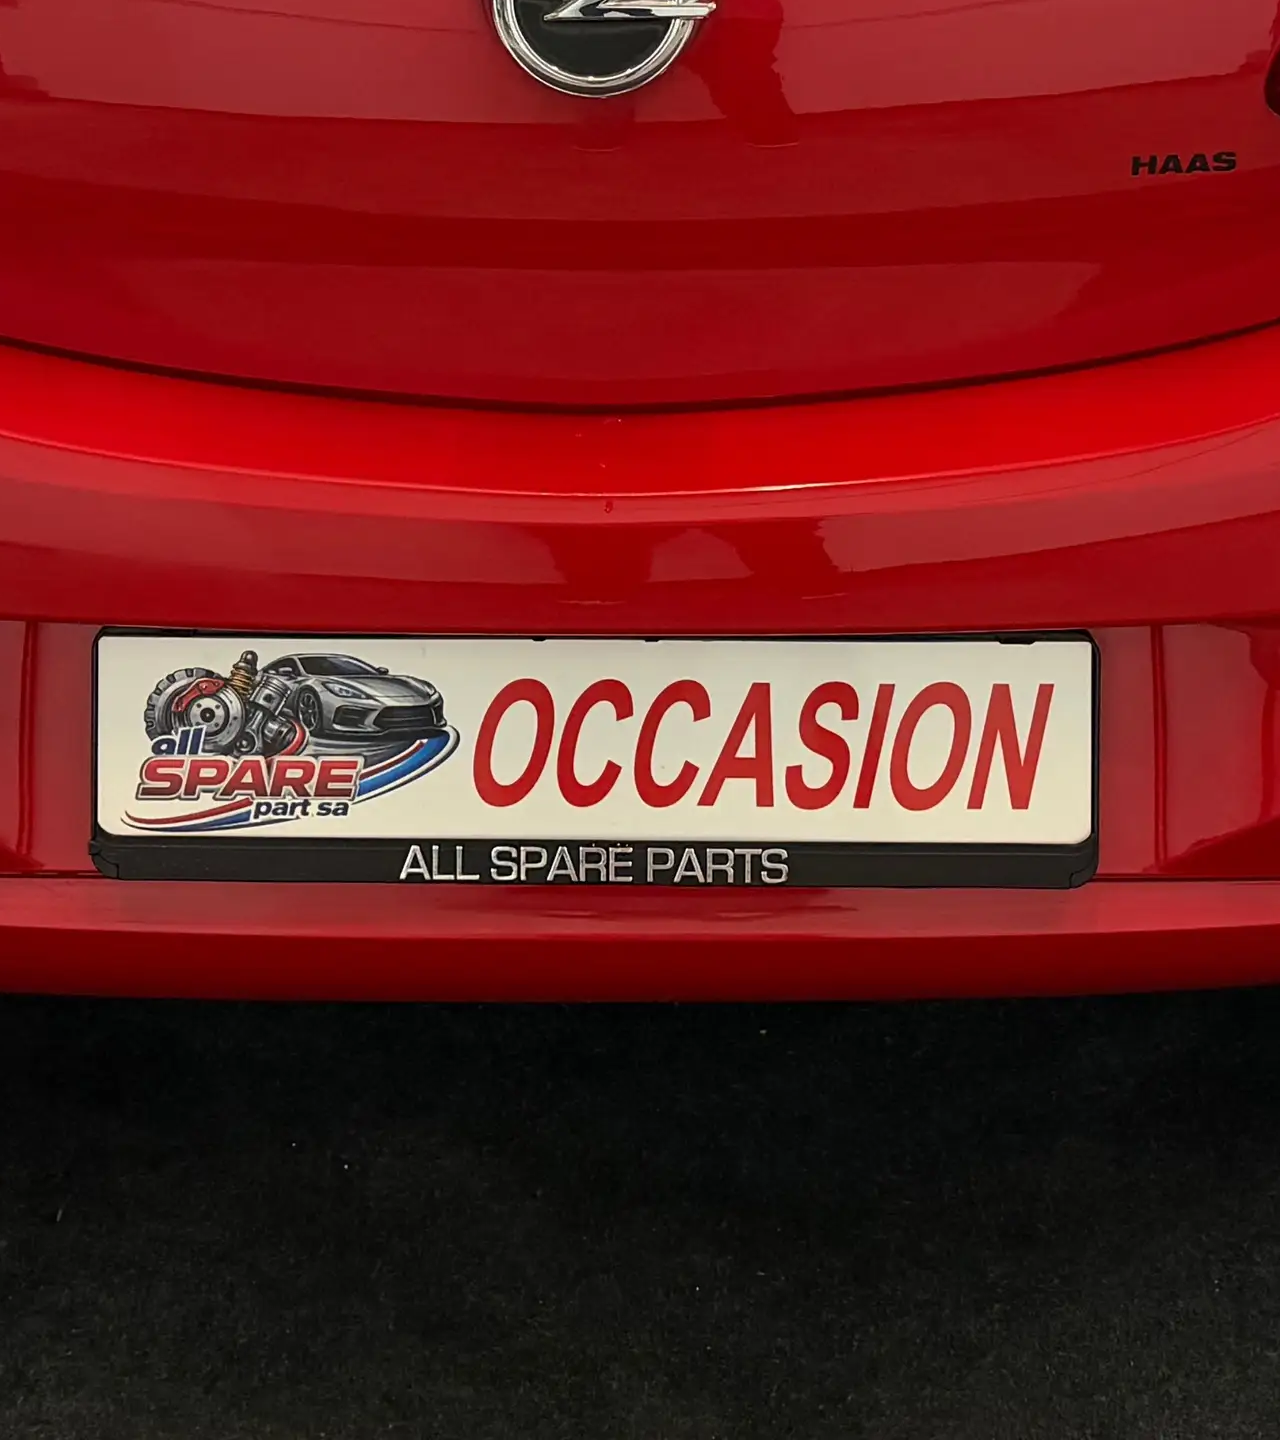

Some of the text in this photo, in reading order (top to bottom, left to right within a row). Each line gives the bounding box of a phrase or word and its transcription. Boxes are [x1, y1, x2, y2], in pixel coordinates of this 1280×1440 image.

[1131, 151, 1238, 176] HAAS
[151, 727, 205, 755] all
[474, 679, 1054, 811] OCCASION
[137, 757, 362, 800] SPARE
[253, 798, 350, 819] part sa
[399, 845, 789, 884] ALL SPARE PARTS
